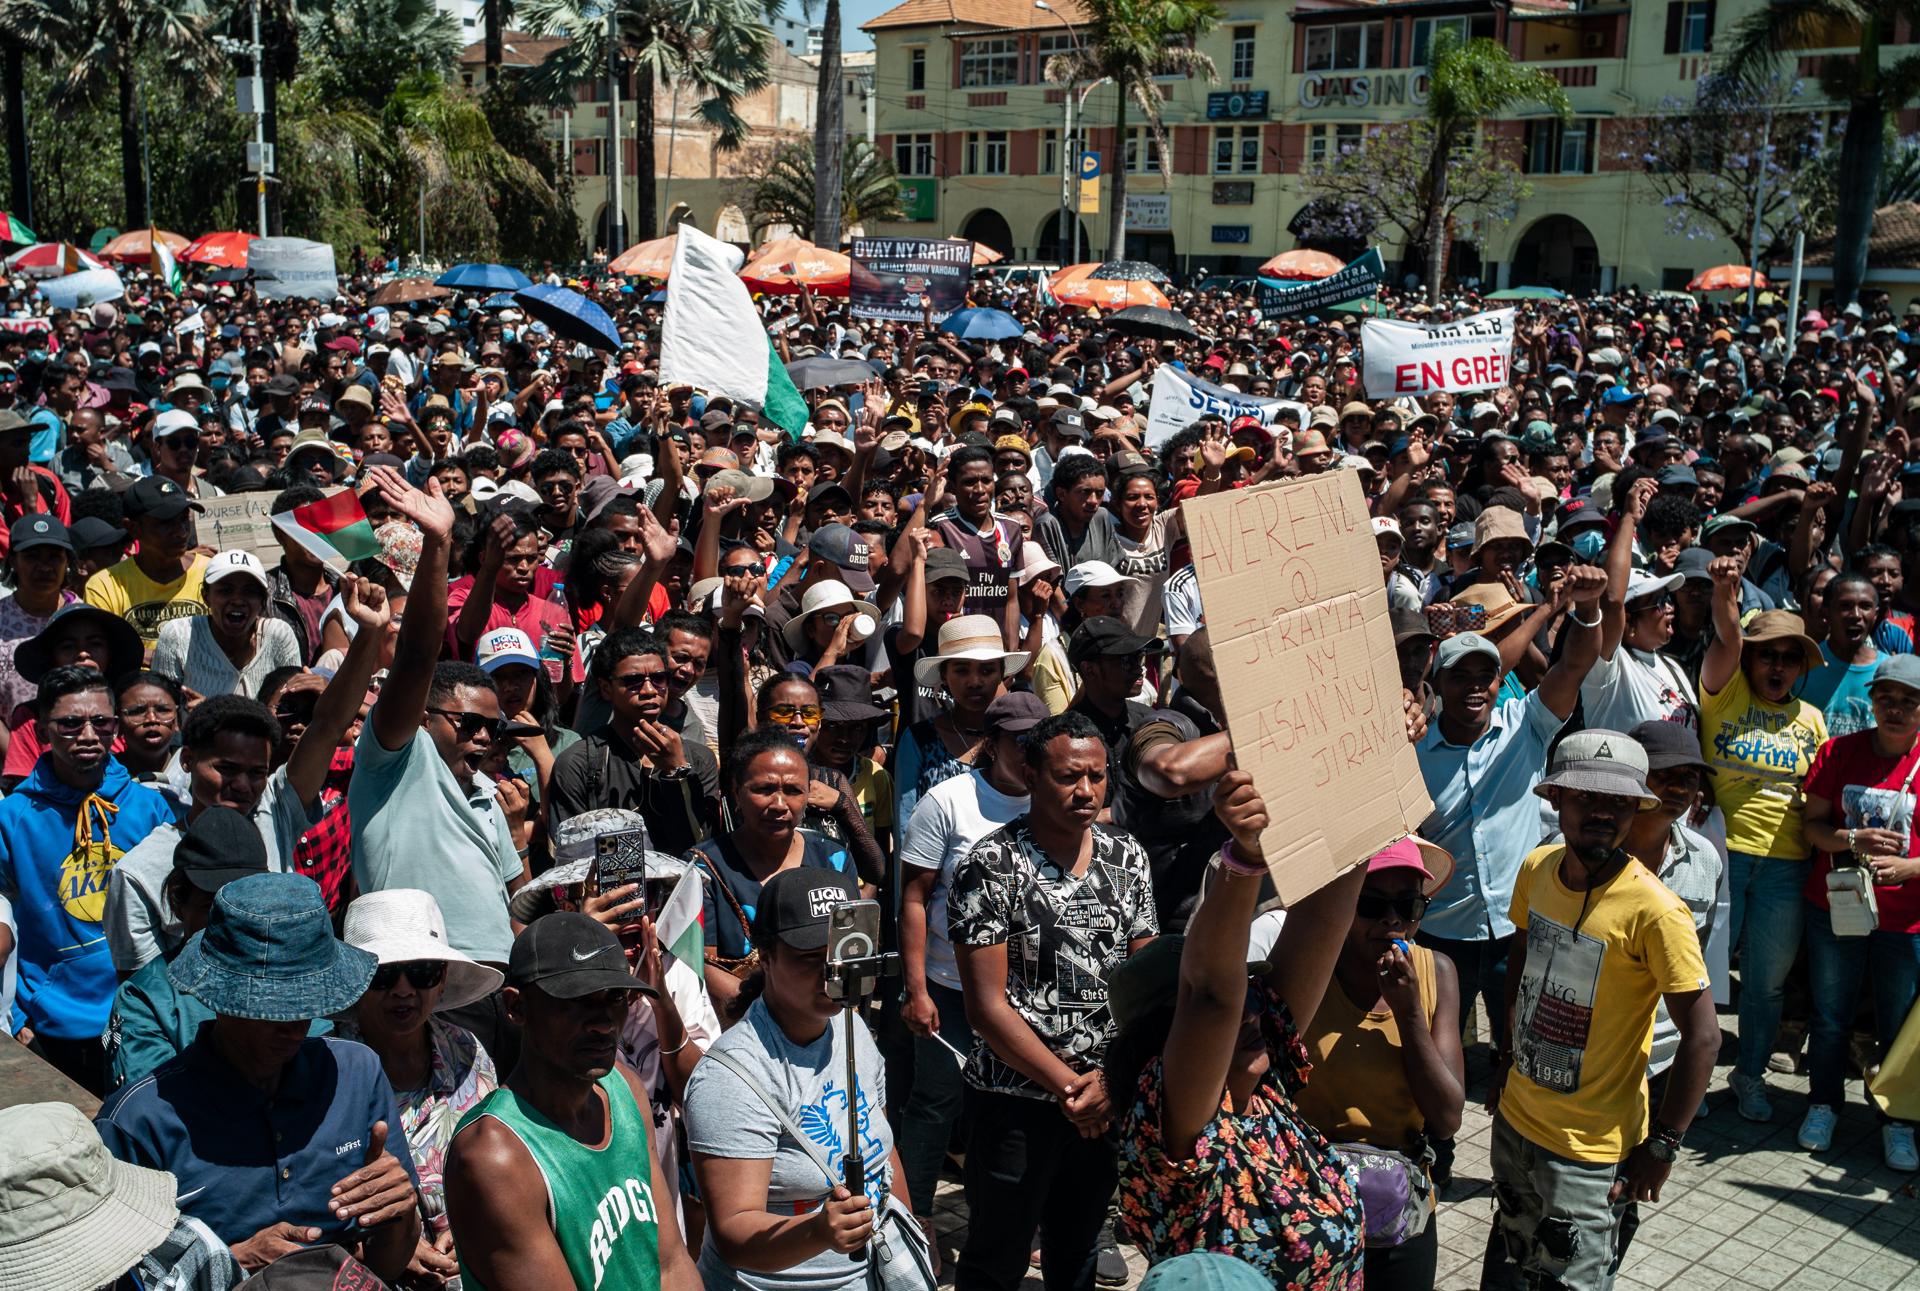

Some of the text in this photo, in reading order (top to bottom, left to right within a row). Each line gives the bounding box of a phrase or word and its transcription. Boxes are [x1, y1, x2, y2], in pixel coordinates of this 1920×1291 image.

[1299, 71, 1430, 109] CASINO
[895, 241, 915, 258] NY
[918, 243, 971, 263] RAFITRA
[930, 264, 960, 276] VAHOAKA
[1304, 298, 1320, 309] TSY
[1343, 282, 1378, 298] FEPETRA
[1395, 360, 1446, 392] EN
[198, 504, 242, 519] BOURSE
[854, 543, 869, 554] NE
[230, 552, 251, 566] CA
[979, 572, 994, 584] Fly
[1280, 556, 1318, 603] @
[172, 605, 196, 616] BEACH
[1234, 594, 1365, 665] JIRAMA
[492, 635, 520, 645] LIQUI
[493, 641, 521, 652] MOLY
[1306, 640, 1339, 680] NY
[810, 888, 846, 902] LIQUI
[812, 900, 839, 916] MO
[1080, 989, 1097, 1000] The
[1535, 1063, 1572, 1087] 1930
[335, 1139, 362, 1156] UniFirst
